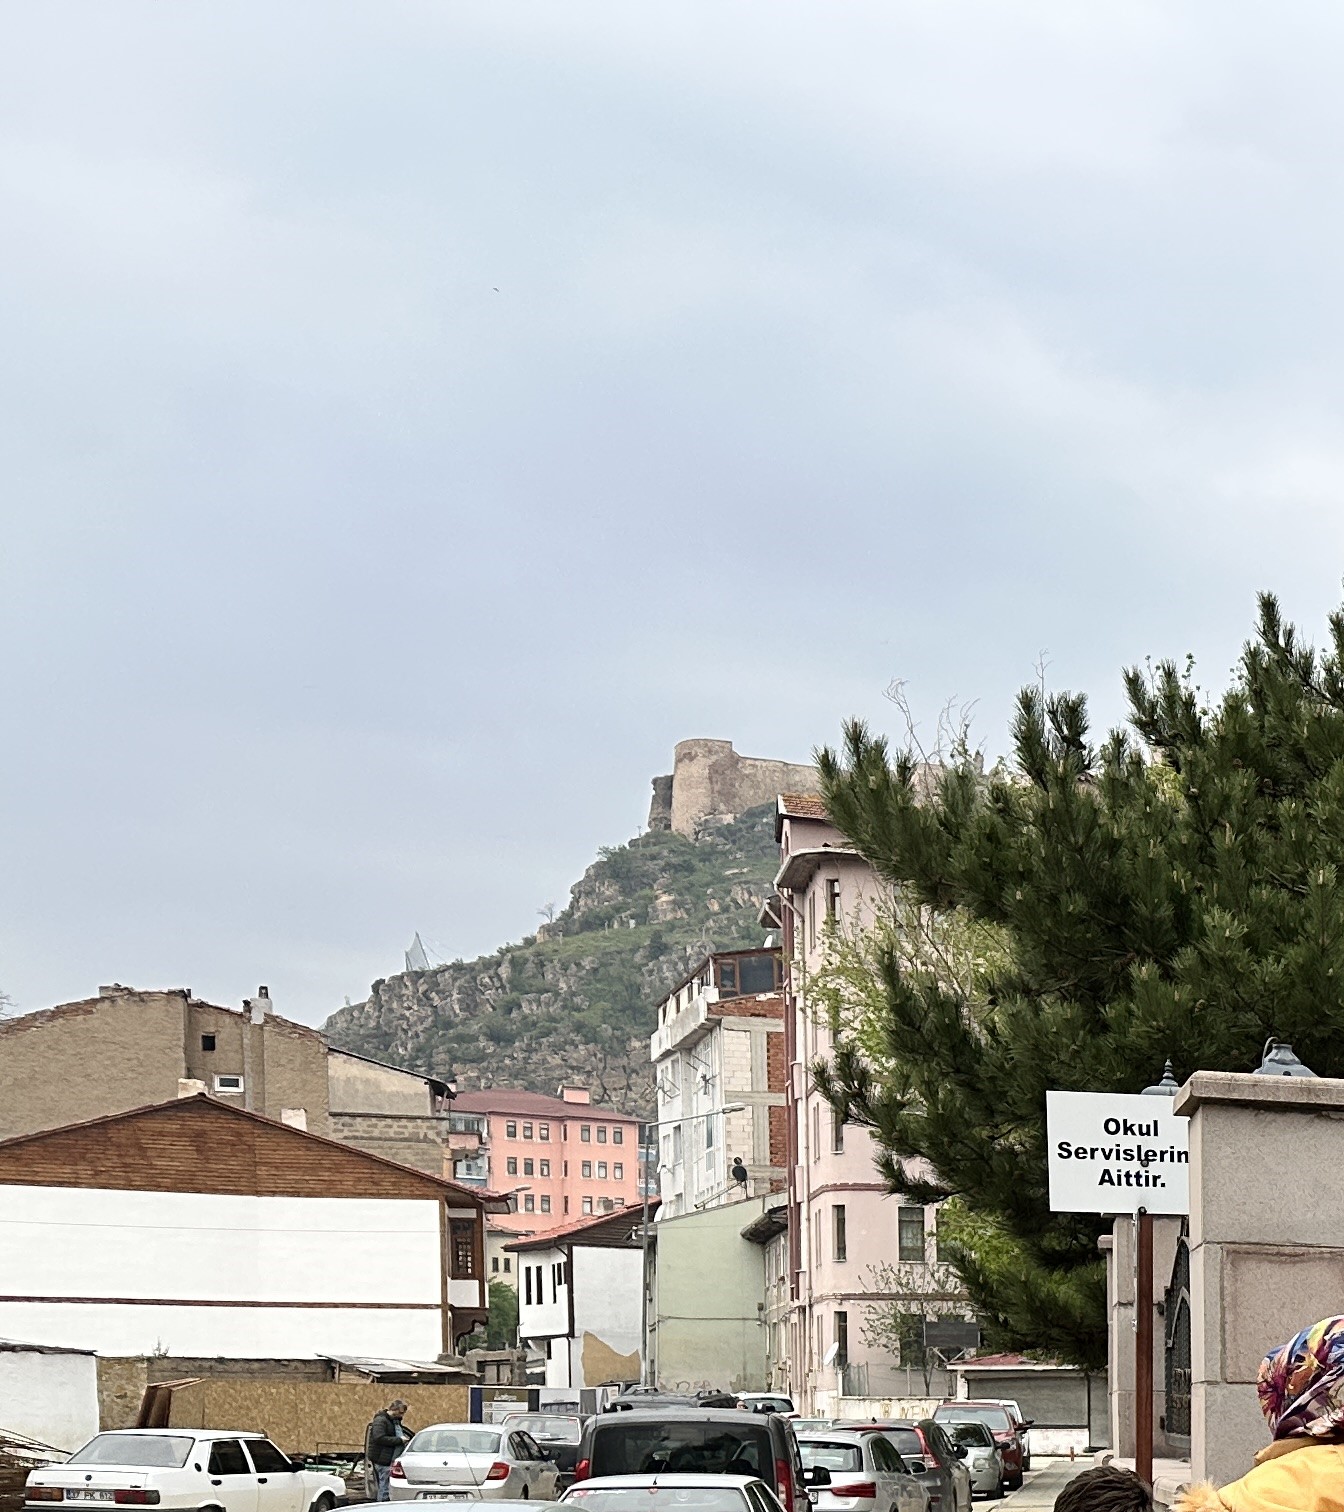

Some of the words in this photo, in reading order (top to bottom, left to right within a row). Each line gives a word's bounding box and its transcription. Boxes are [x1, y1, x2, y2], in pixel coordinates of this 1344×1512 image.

[1103, 1117, 1159, 1137] Okul
[1057, 1141, 1189, 1163] Servislerin
[1098, 1168, 1166, 1188] Aittir.
